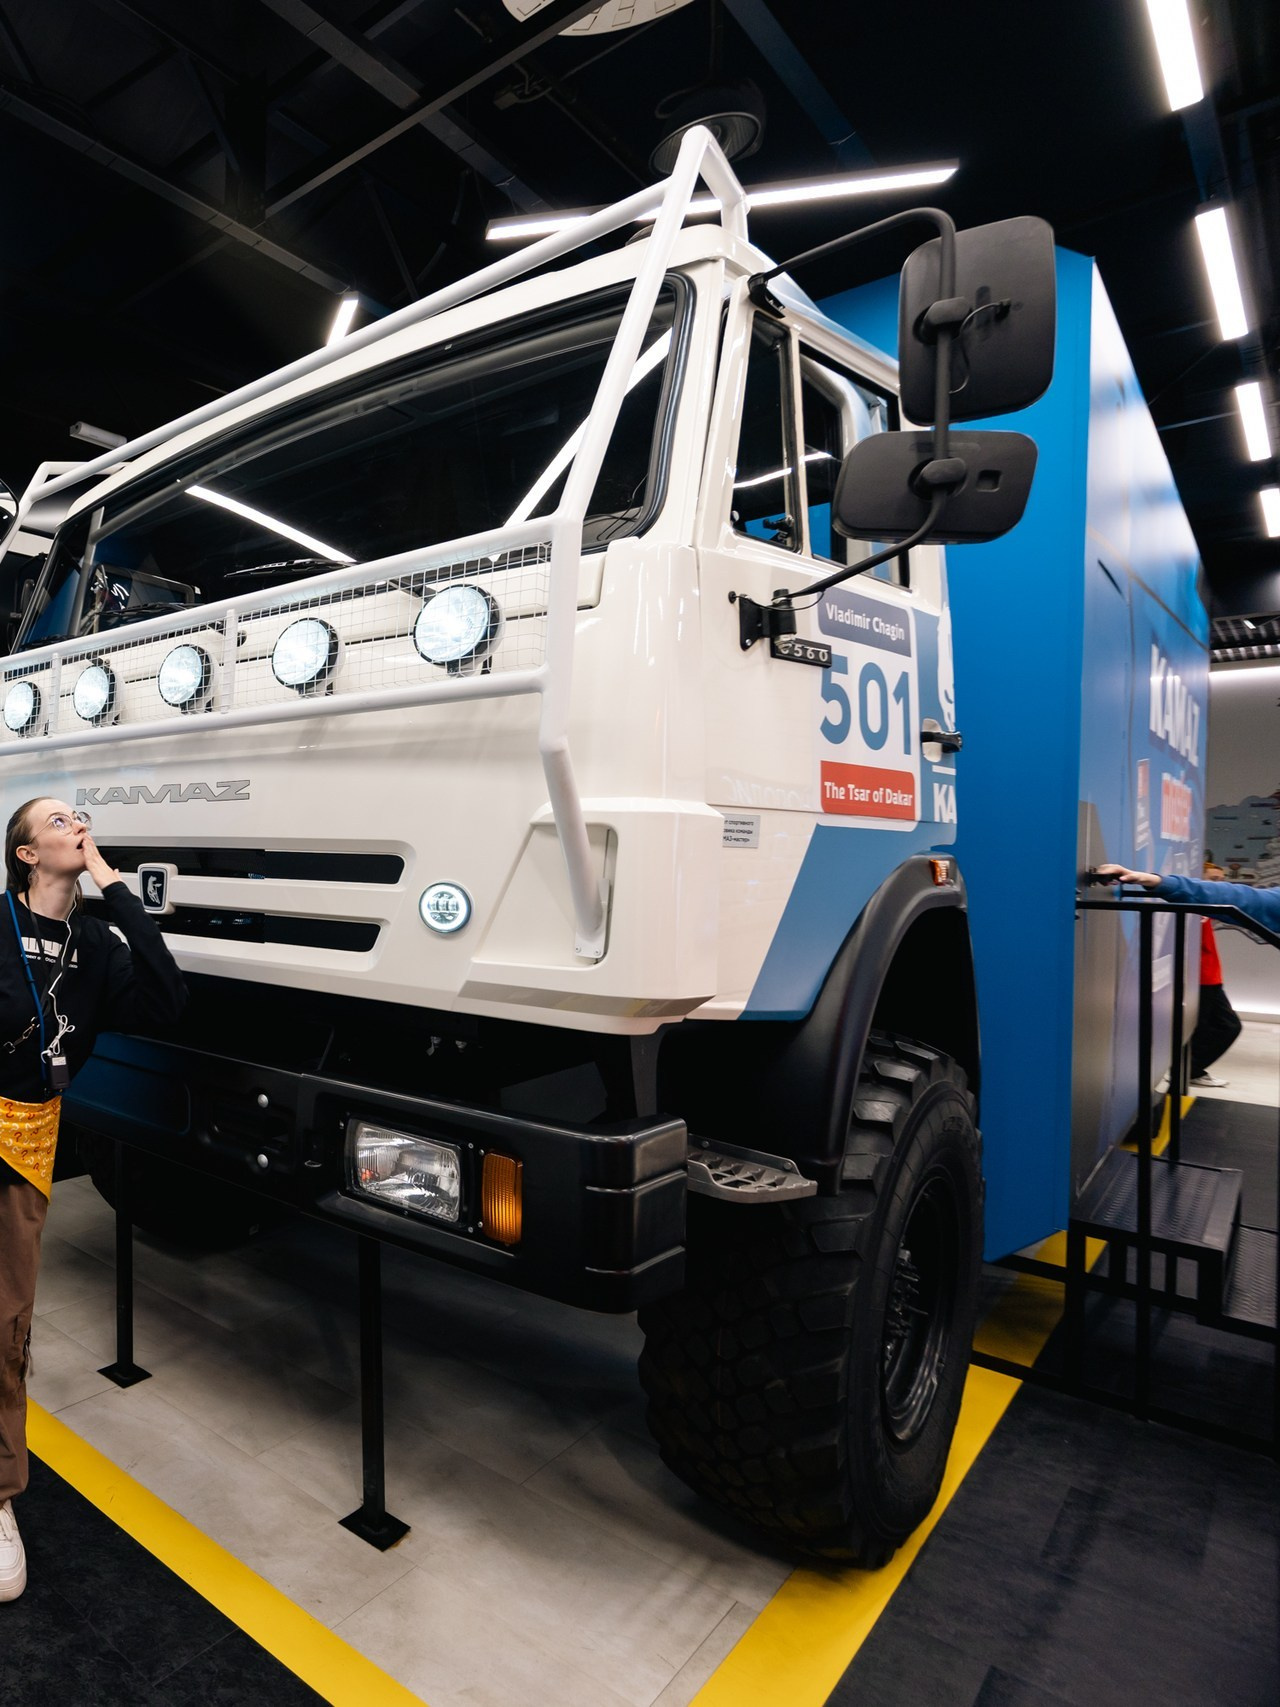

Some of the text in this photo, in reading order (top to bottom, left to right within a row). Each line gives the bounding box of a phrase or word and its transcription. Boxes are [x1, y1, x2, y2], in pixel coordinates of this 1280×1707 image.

[825, 602, 905, 641] Vladimir Chagin
[820, 653, 912, 756] 501
[76, 779, 251, 806] KAMAZ
[824, 781, 913, 807] The Tsar of Dakar
